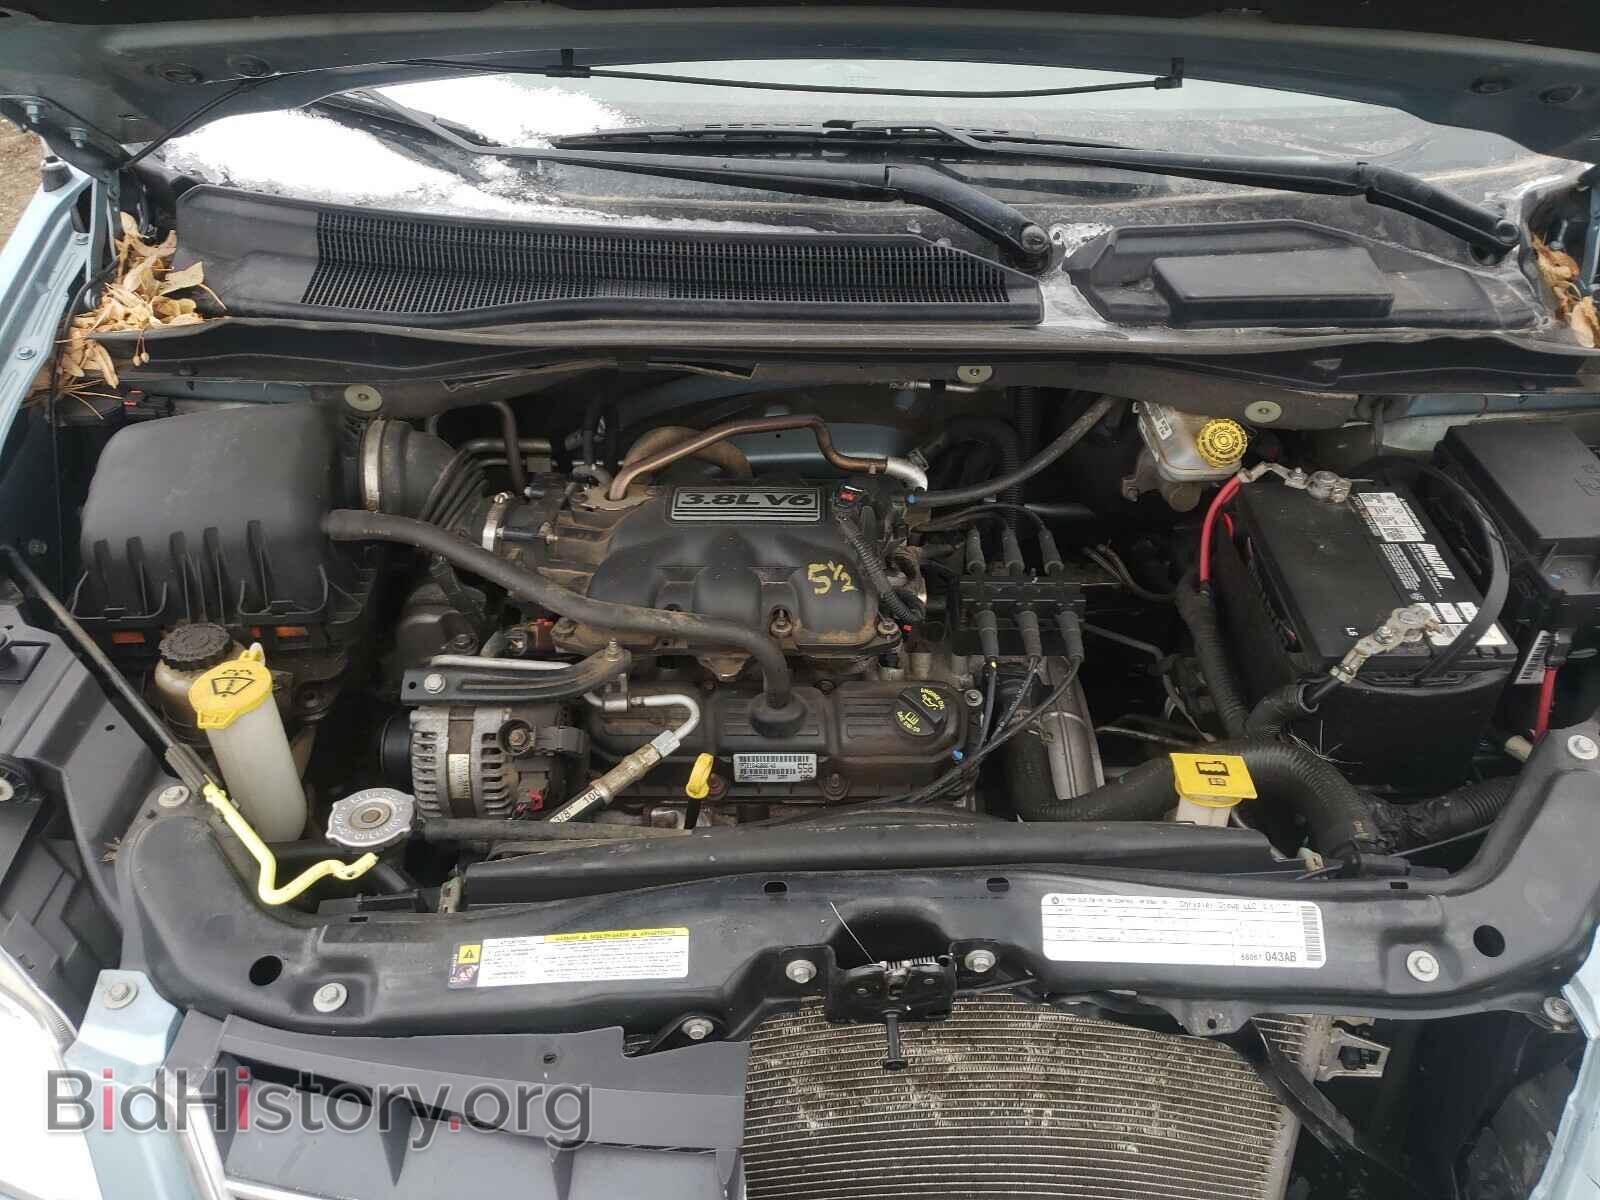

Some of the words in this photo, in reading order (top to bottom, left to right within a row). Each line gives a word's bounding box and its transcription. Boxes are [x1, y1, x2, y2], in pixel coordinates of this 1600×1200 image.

[682, 494, 760, 505] 3.8L
[763, 494, 812, 505] V6
[1265, 951, 1297, 961] 043AB
